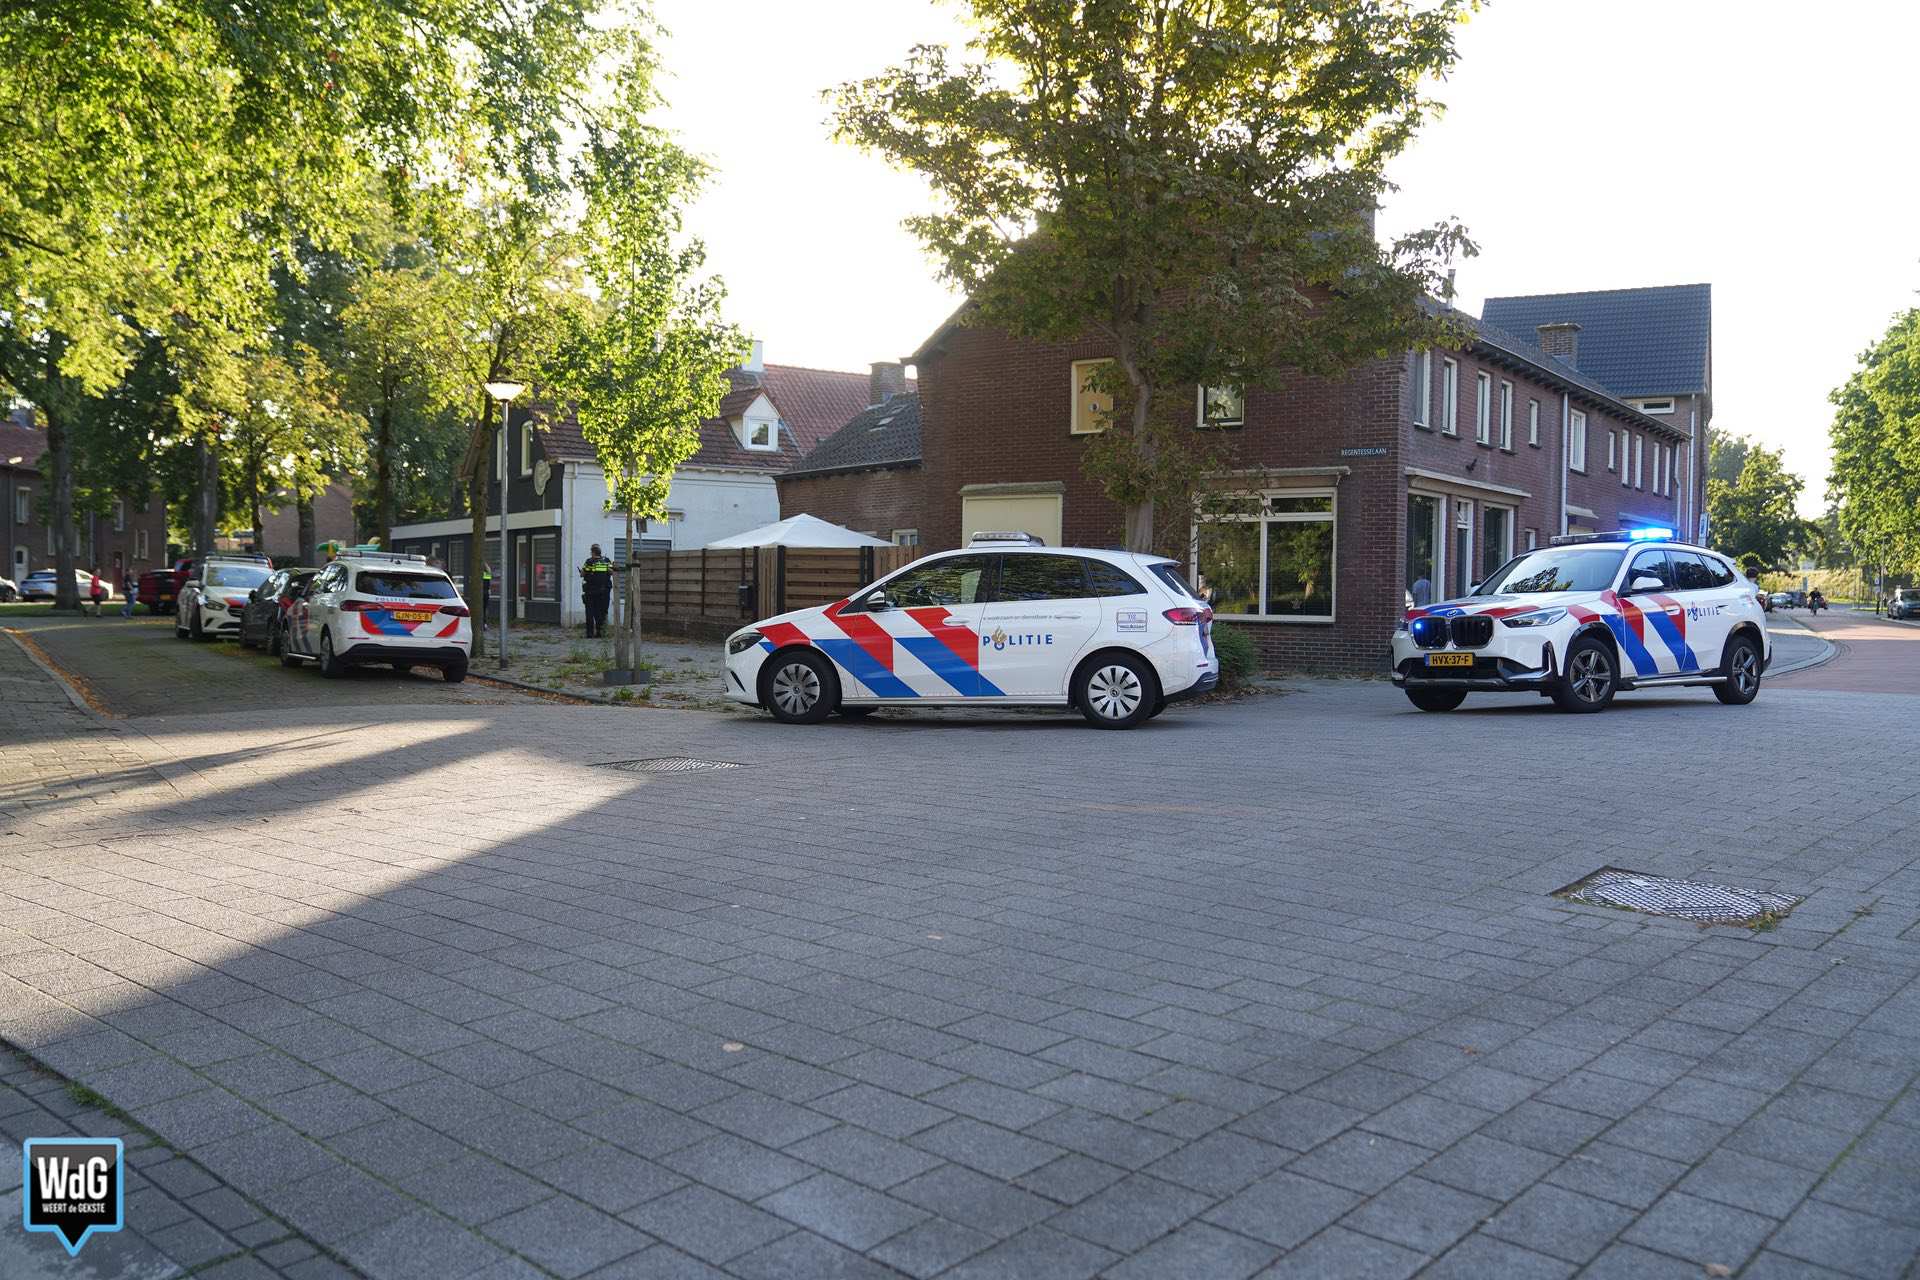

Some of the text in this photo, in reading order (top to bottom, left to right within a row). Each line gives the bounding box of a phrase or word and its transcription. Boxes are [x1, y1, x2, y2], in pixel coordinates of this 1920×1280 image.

[1341, 447, 1387, 457] REGENTESSELAAN
[1687, 606, 1721, 621] POLITIE
[982, 633, 1053, 651] POLITIE
[1432, 655, 1470, 665] HVX-37-F
